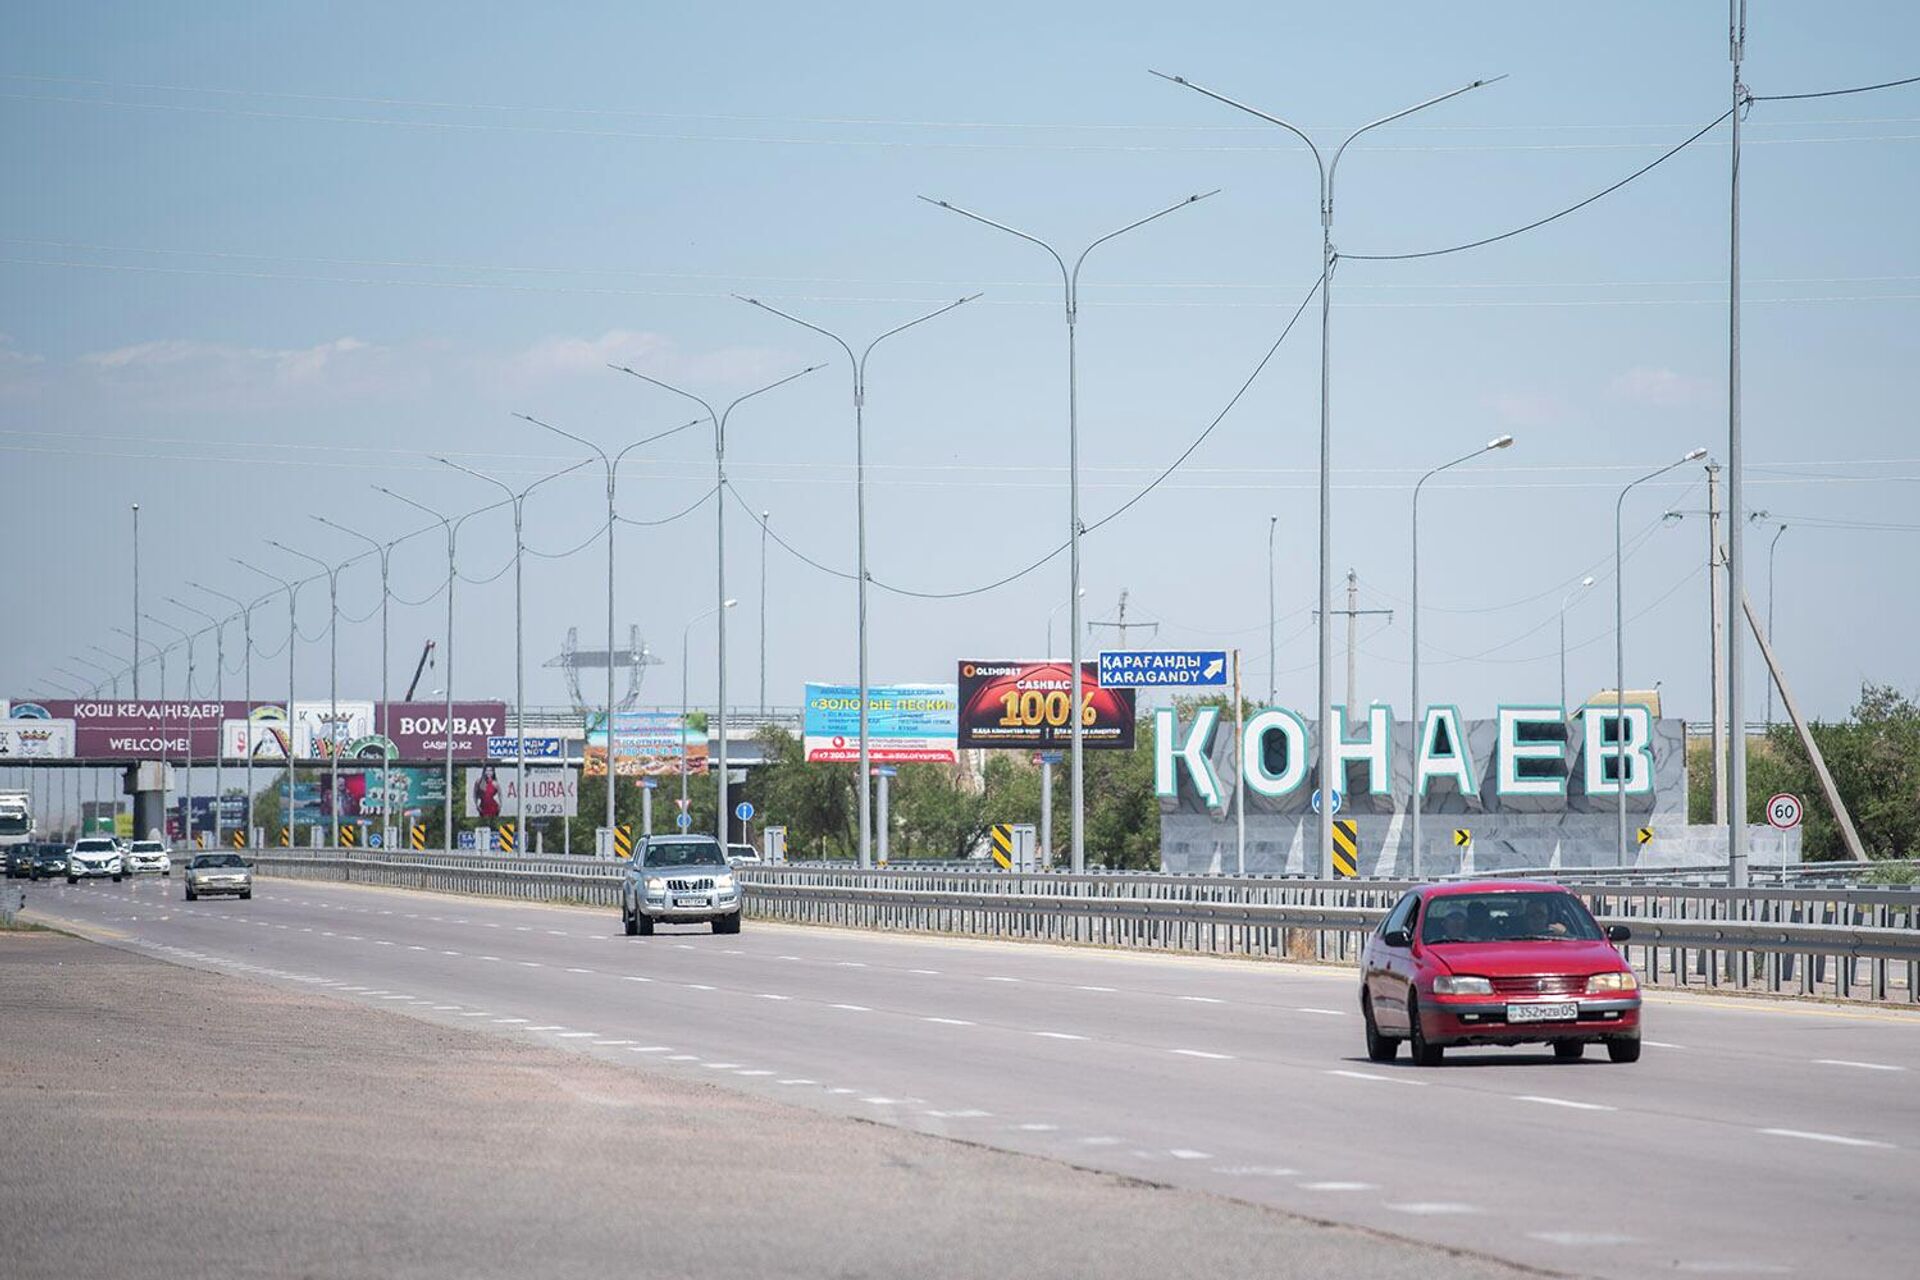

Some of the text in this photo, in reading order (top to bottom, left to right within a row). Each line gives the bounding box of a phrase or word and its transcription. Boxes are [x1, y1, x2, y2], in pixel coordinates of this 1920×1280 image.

[1102, 655, 1200, 670] ҚАРАҒАНДЫ
[1102, 671, 1200, 683] KARAGANDY
[1016, 680, 1073, 690] CASHBAC
[811, 698, 893, 711] «ЗОЛОЫЕ
[1000, 690, 1097, 726] 100%
[399, 717, 497, 735] BOMBAY
[109, 738, 191, 751] WELCOME!
[507, 781, 530, 798] AI
[1775, 804, 1794, 819] 60
